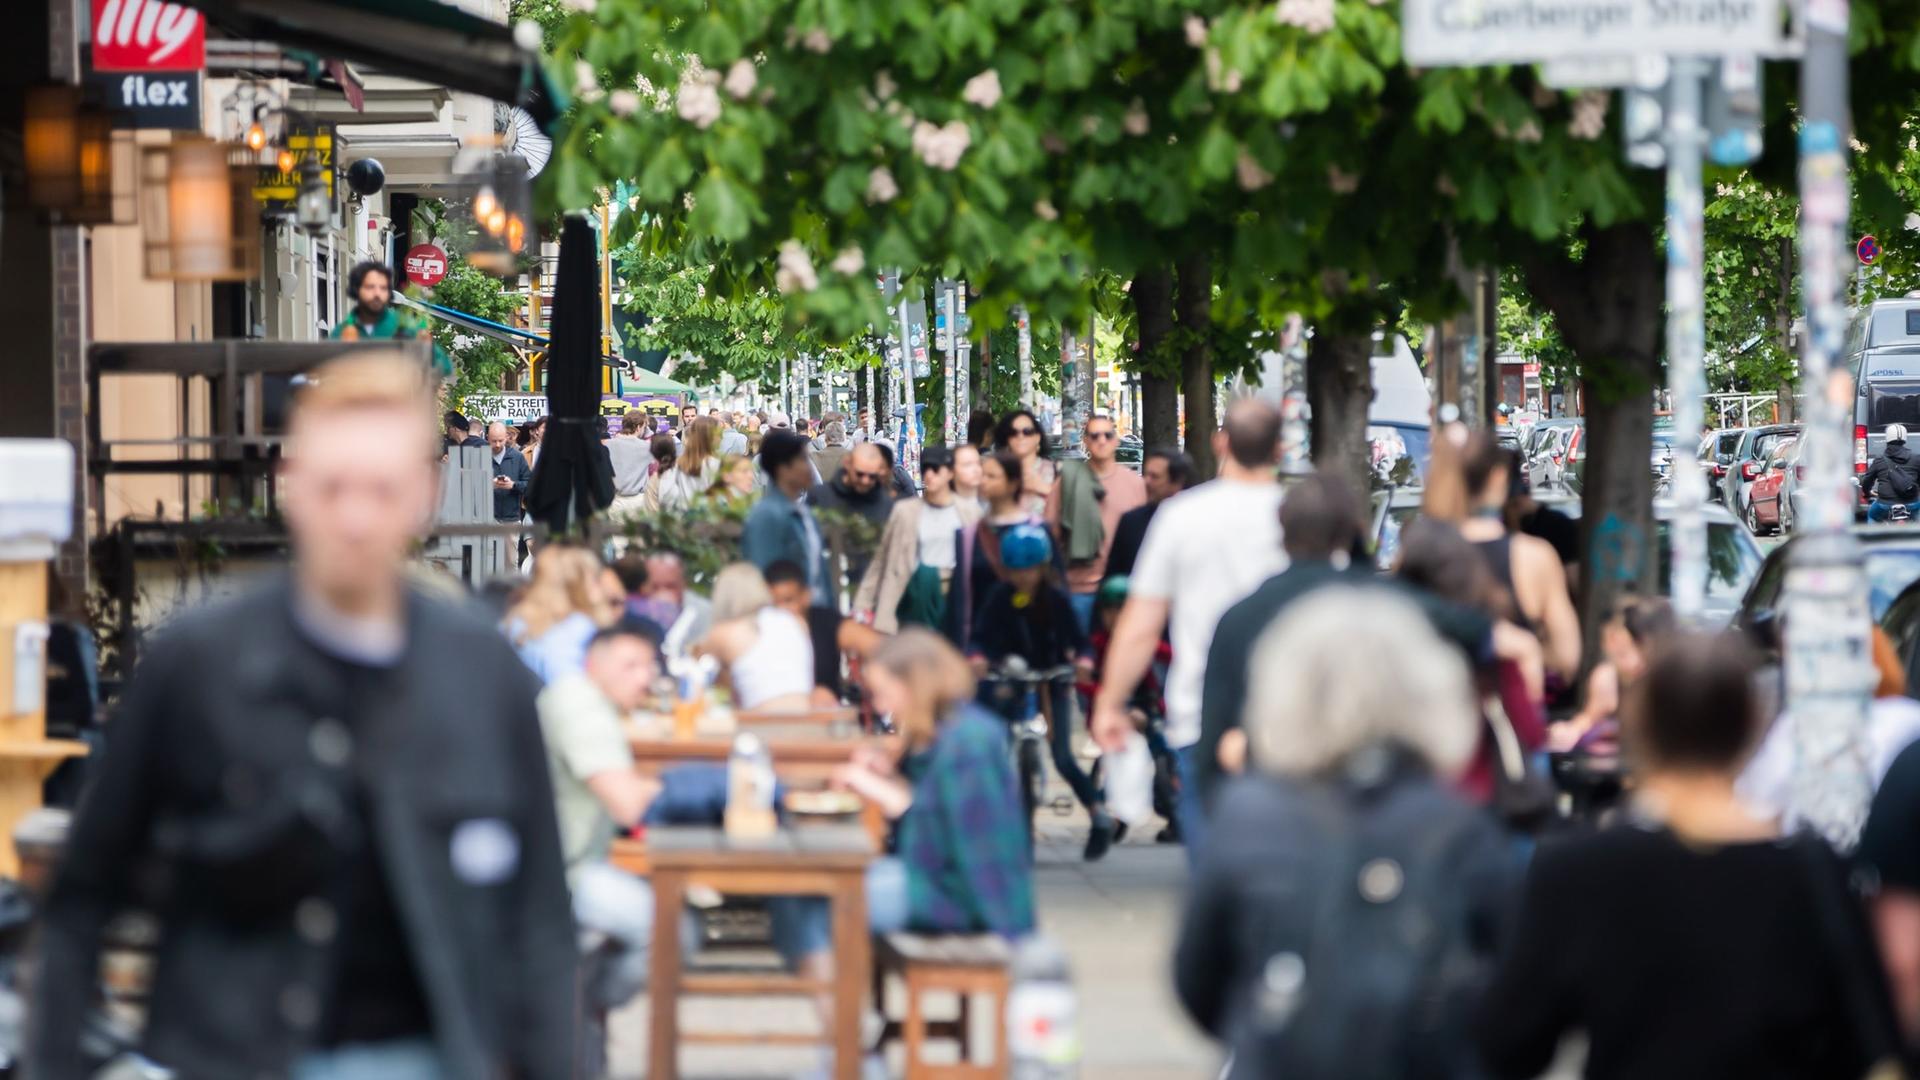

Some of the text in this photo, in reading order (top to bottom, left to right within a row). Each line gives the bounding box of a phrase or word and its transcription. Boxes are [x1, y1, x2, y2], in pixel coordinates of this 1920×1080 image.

[122, 75, 188, 106] flex
[508, 398, 546, 408] STREIT
[508, 408, 541, 417] RAUM
